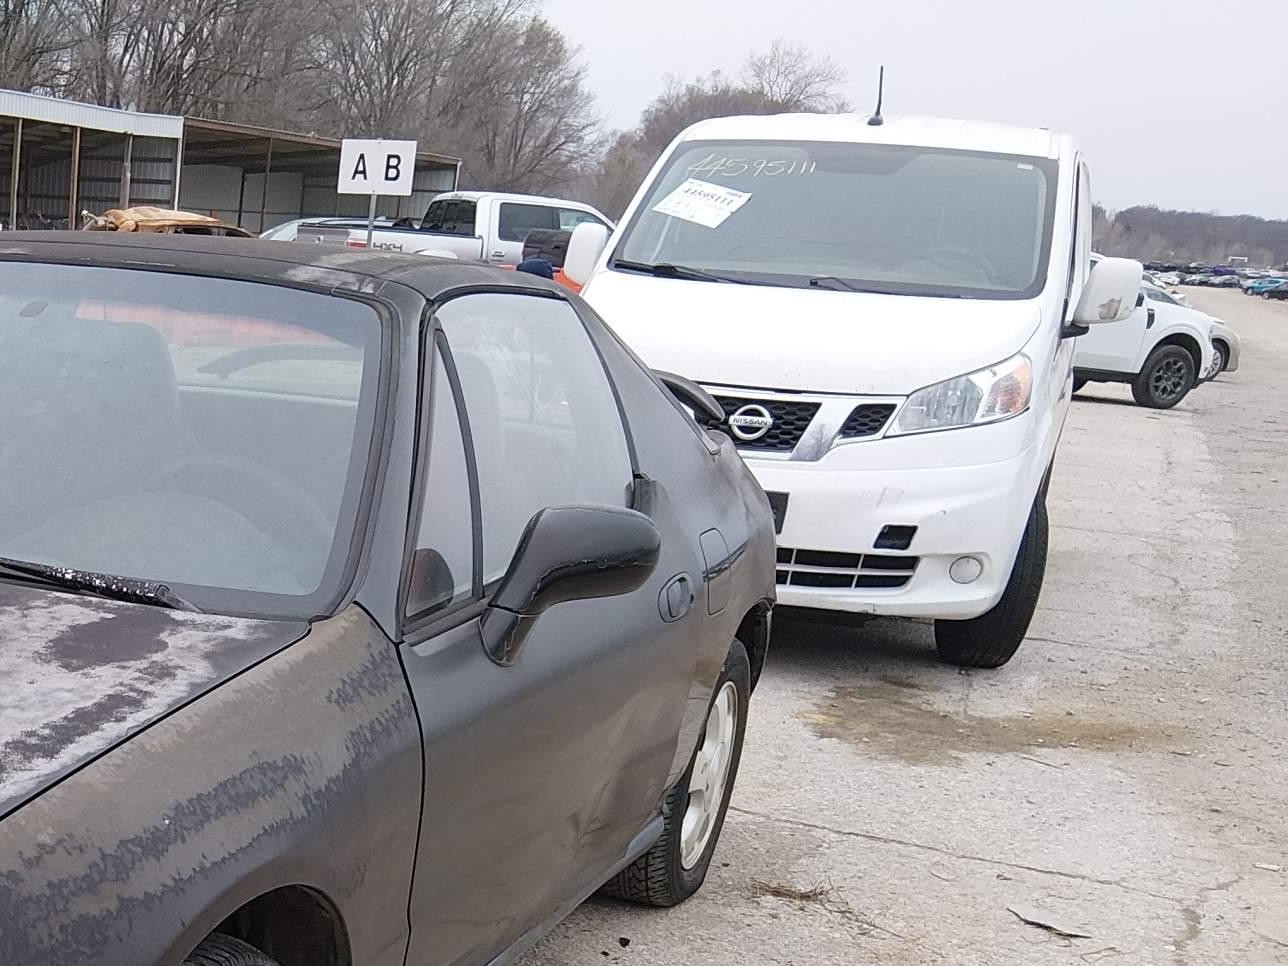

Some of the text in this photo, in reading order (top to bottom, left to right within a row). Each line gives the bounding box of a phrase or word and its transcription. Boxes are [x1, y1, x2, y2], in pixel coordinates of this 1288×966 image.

[351, 152, 402, 182] A B
[687, 153, 816, 177] 44595111
[732, 417, 768, 426] NISSAN
